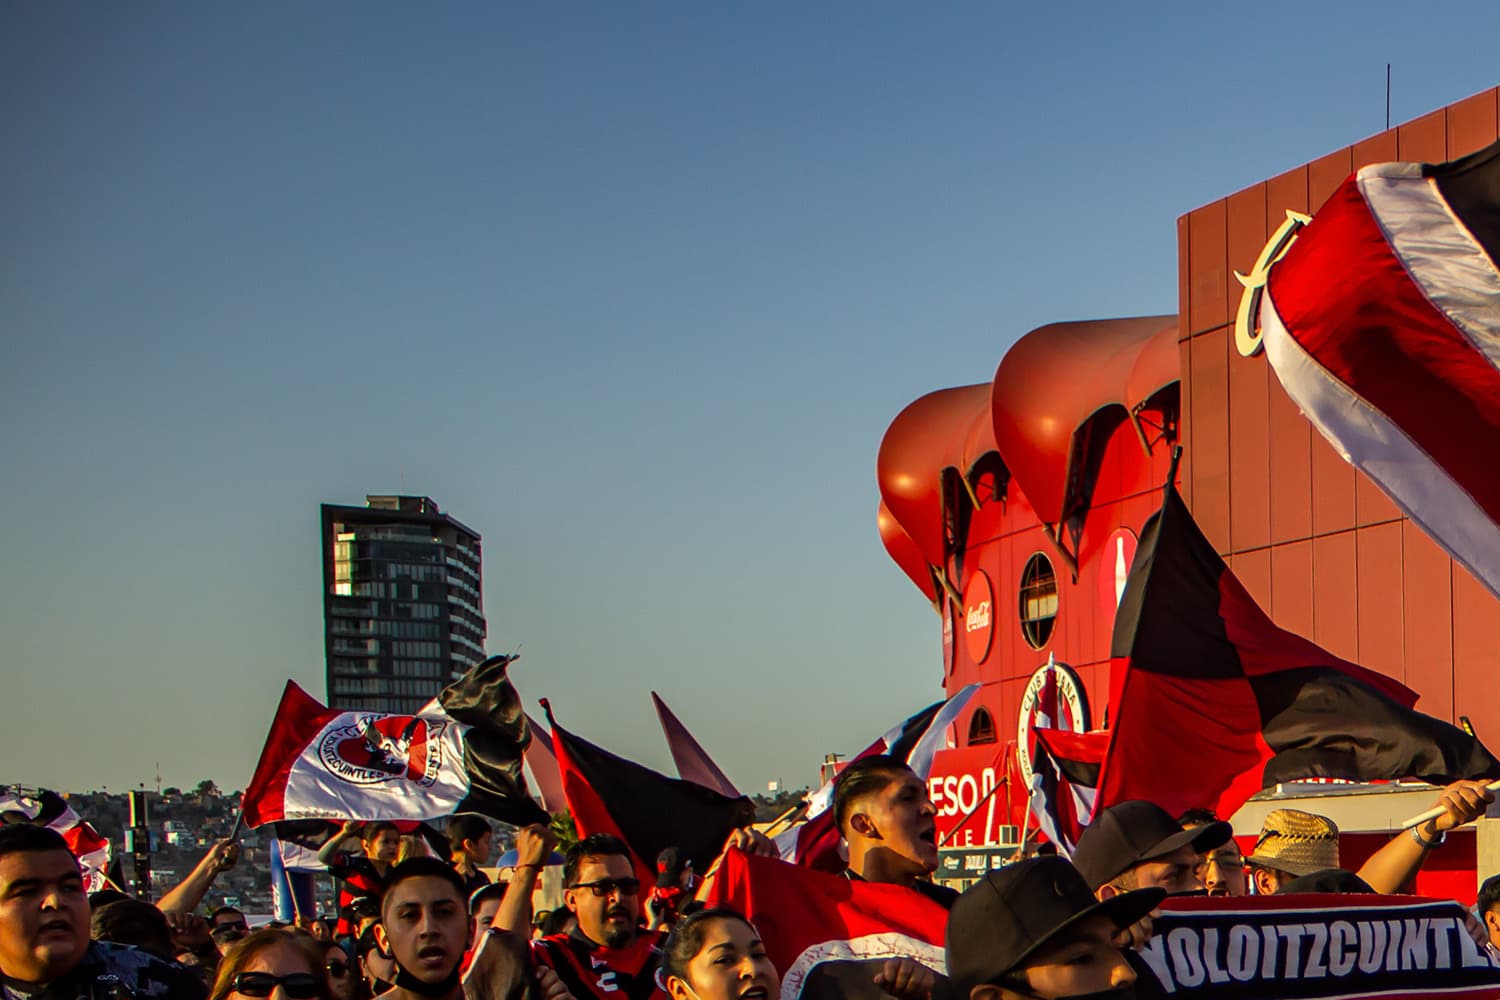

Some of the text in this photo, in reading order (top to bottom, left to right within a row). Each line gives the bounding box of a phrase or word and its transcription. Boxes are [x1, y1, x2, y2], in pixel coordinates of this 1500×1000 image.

[1024, 675, 1042, 712] CLUB
[925, 773, 978, 817] ESO
[1140, 917, 1500, 994] OLOITZCUINTL
